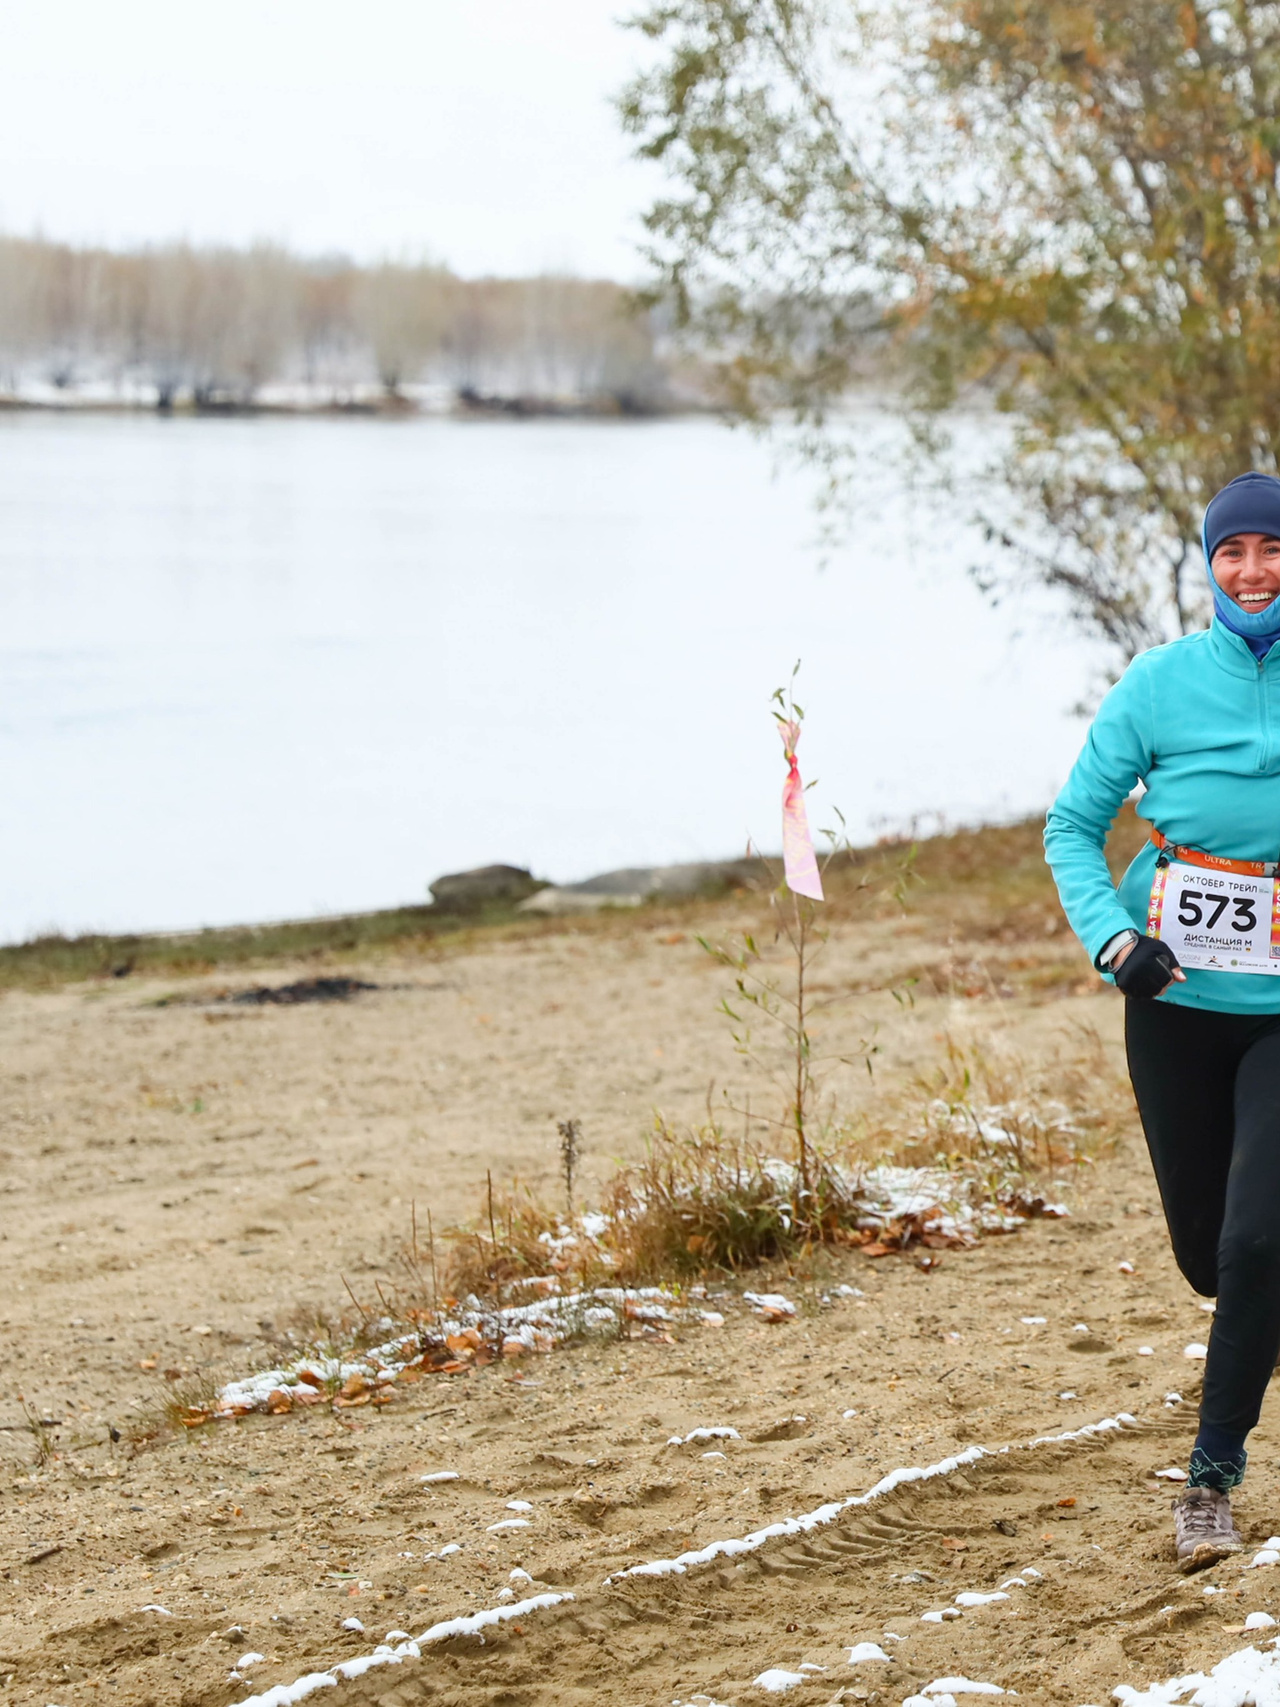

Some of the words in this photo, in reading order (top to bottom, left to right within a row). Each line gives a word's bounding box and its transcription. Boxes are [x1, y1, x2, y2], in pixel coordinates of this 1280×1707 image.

[1204, 854, 1232, 866] ULTRA
[1183, 875, 1224, 888] ОКТОБЕР
[1229, 882, 1258, 893] ТРЕЙЛ
[1150, 898, 1160, 919] TRAIL
[1155, 871, 1164, 896] SERIES
[1177, 889, 1257, 932] 573
[1183, 933, 1242, 946] ДИСТАНЦИЯ
